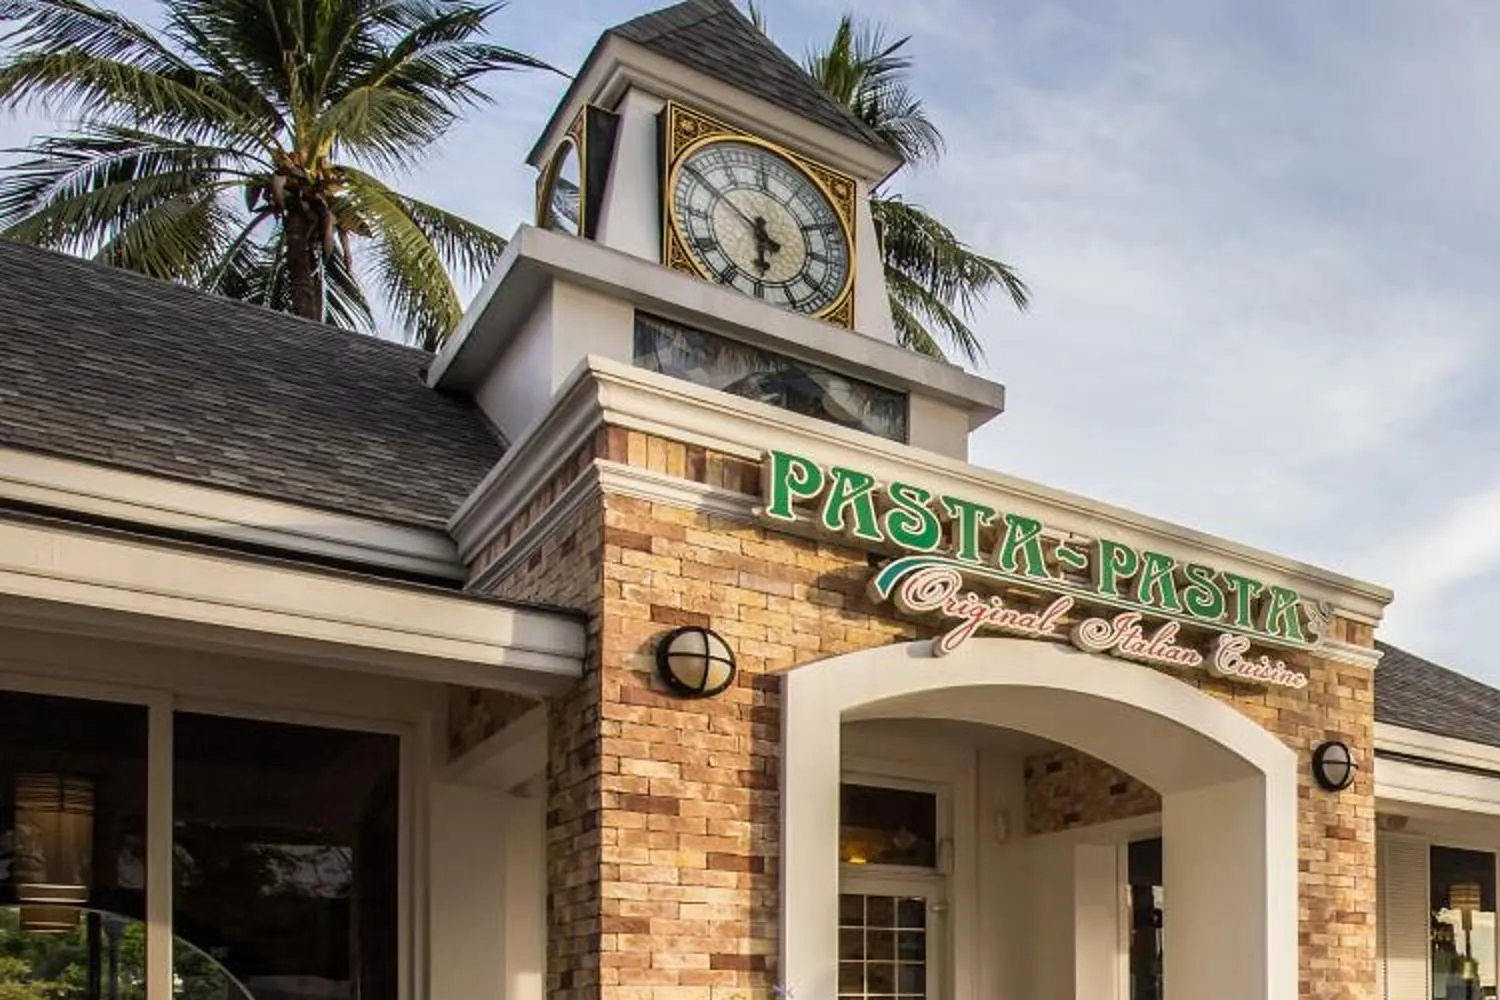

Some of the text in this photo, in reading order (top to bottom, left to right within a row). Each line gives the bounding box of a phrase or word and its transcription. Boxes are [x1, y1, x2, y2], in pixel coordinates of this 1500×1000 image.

[901, 565, 1308, 689] Original Italian Cuisine
